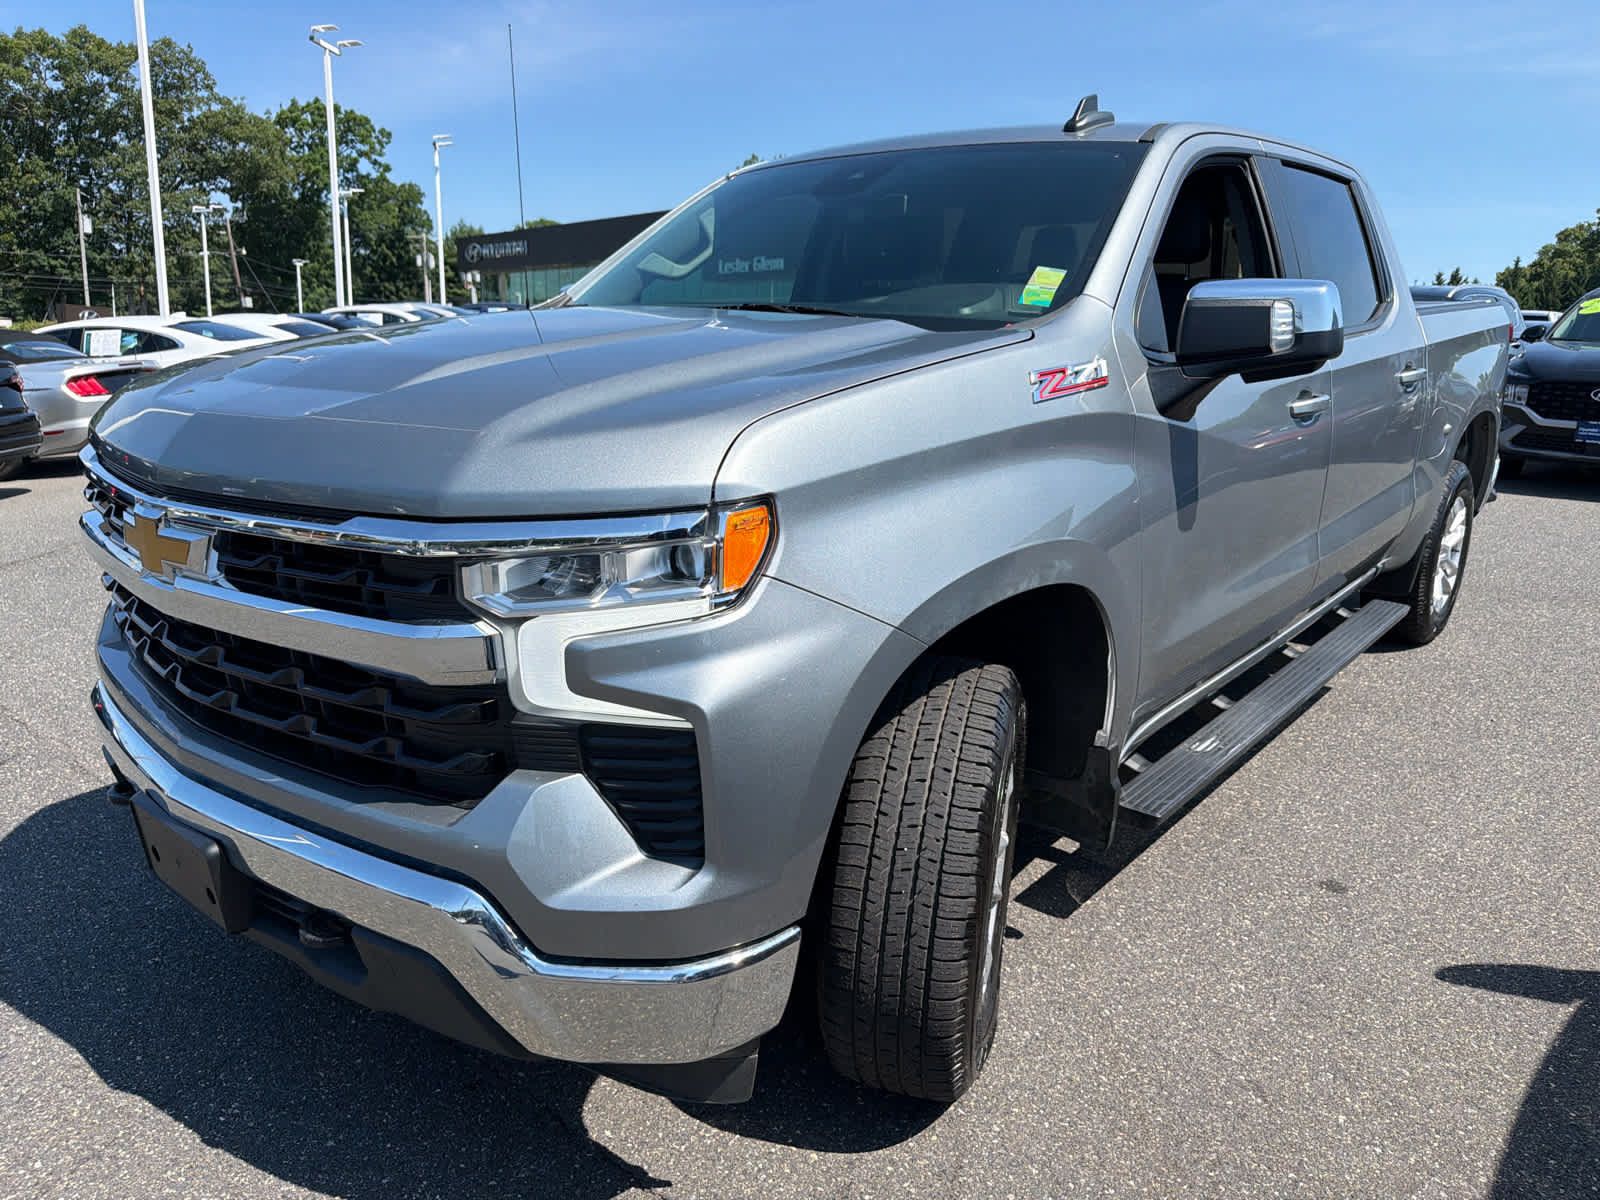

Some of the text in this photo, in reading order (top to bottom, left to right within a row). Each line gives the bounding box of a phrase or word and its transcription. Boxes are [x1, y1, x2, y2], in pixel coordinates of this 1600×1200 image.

[719, 256, 785, 274] Lester Glenn
[1029, 355, 1109, 404] Z71
